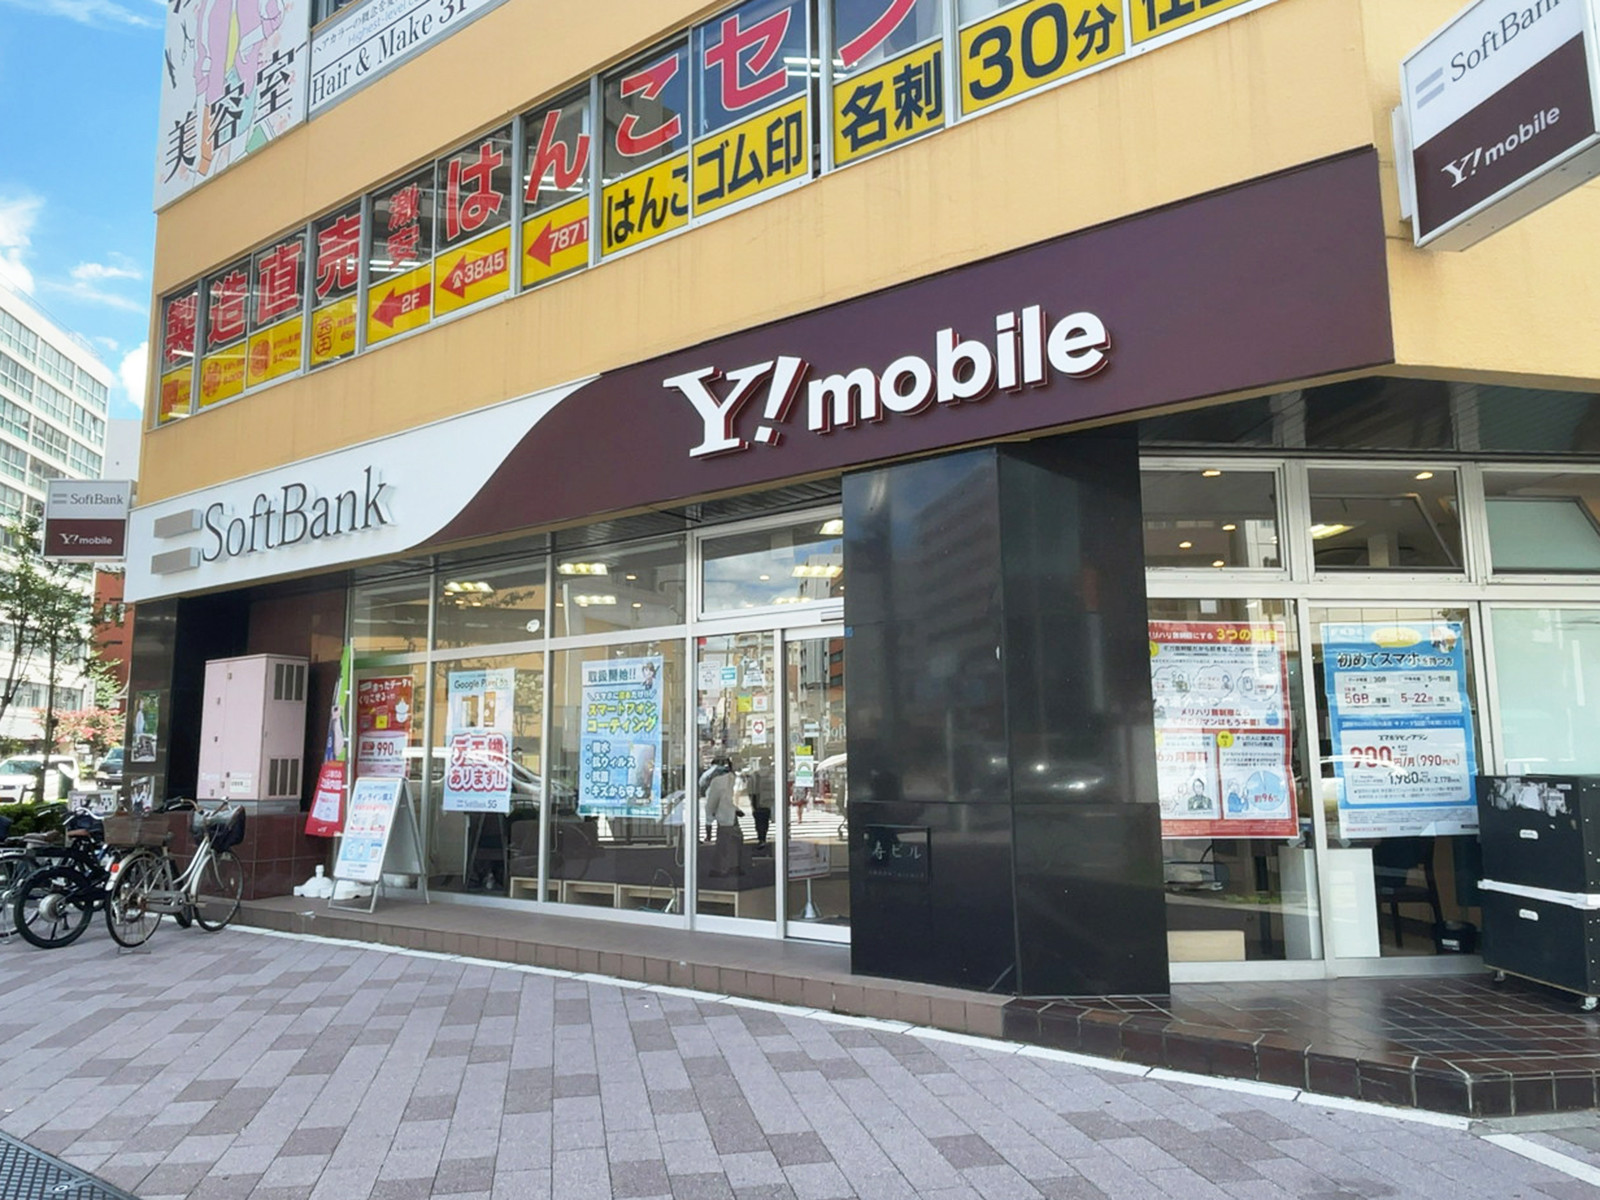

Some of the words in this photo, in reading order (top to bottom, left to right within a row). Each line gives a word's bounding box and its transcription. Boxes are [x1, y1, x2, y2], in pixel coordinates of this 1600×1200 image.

[311, 62, 351, 106] Hair
[356, 47, 371, 76] &
[377, 13, 432, 65] Make
[1450, 0, 1561, 82] SoftBan
[164, 48, 295, 184] 美容室
[697, 110, 803, 205] ゴム印
[841, 51, 942, 152] 名刺
[968, 2, 1117, 100] 30分
[165, 213, 362, 363] 製造直売
[401, 292, 420, 313] 2F
[464, 252, 505, 281] 3845
[549, 220, 588, 248] 7871
[70, 493, 124, 505] SoftBank
[202, 465, 390, 562] SoftBank
[454, 679, 480, 691] Google
[1344, 692, 1370, 704] 5GB
[377, 742, 394, 756] 990
[487, 799, 498, 809] 5G
